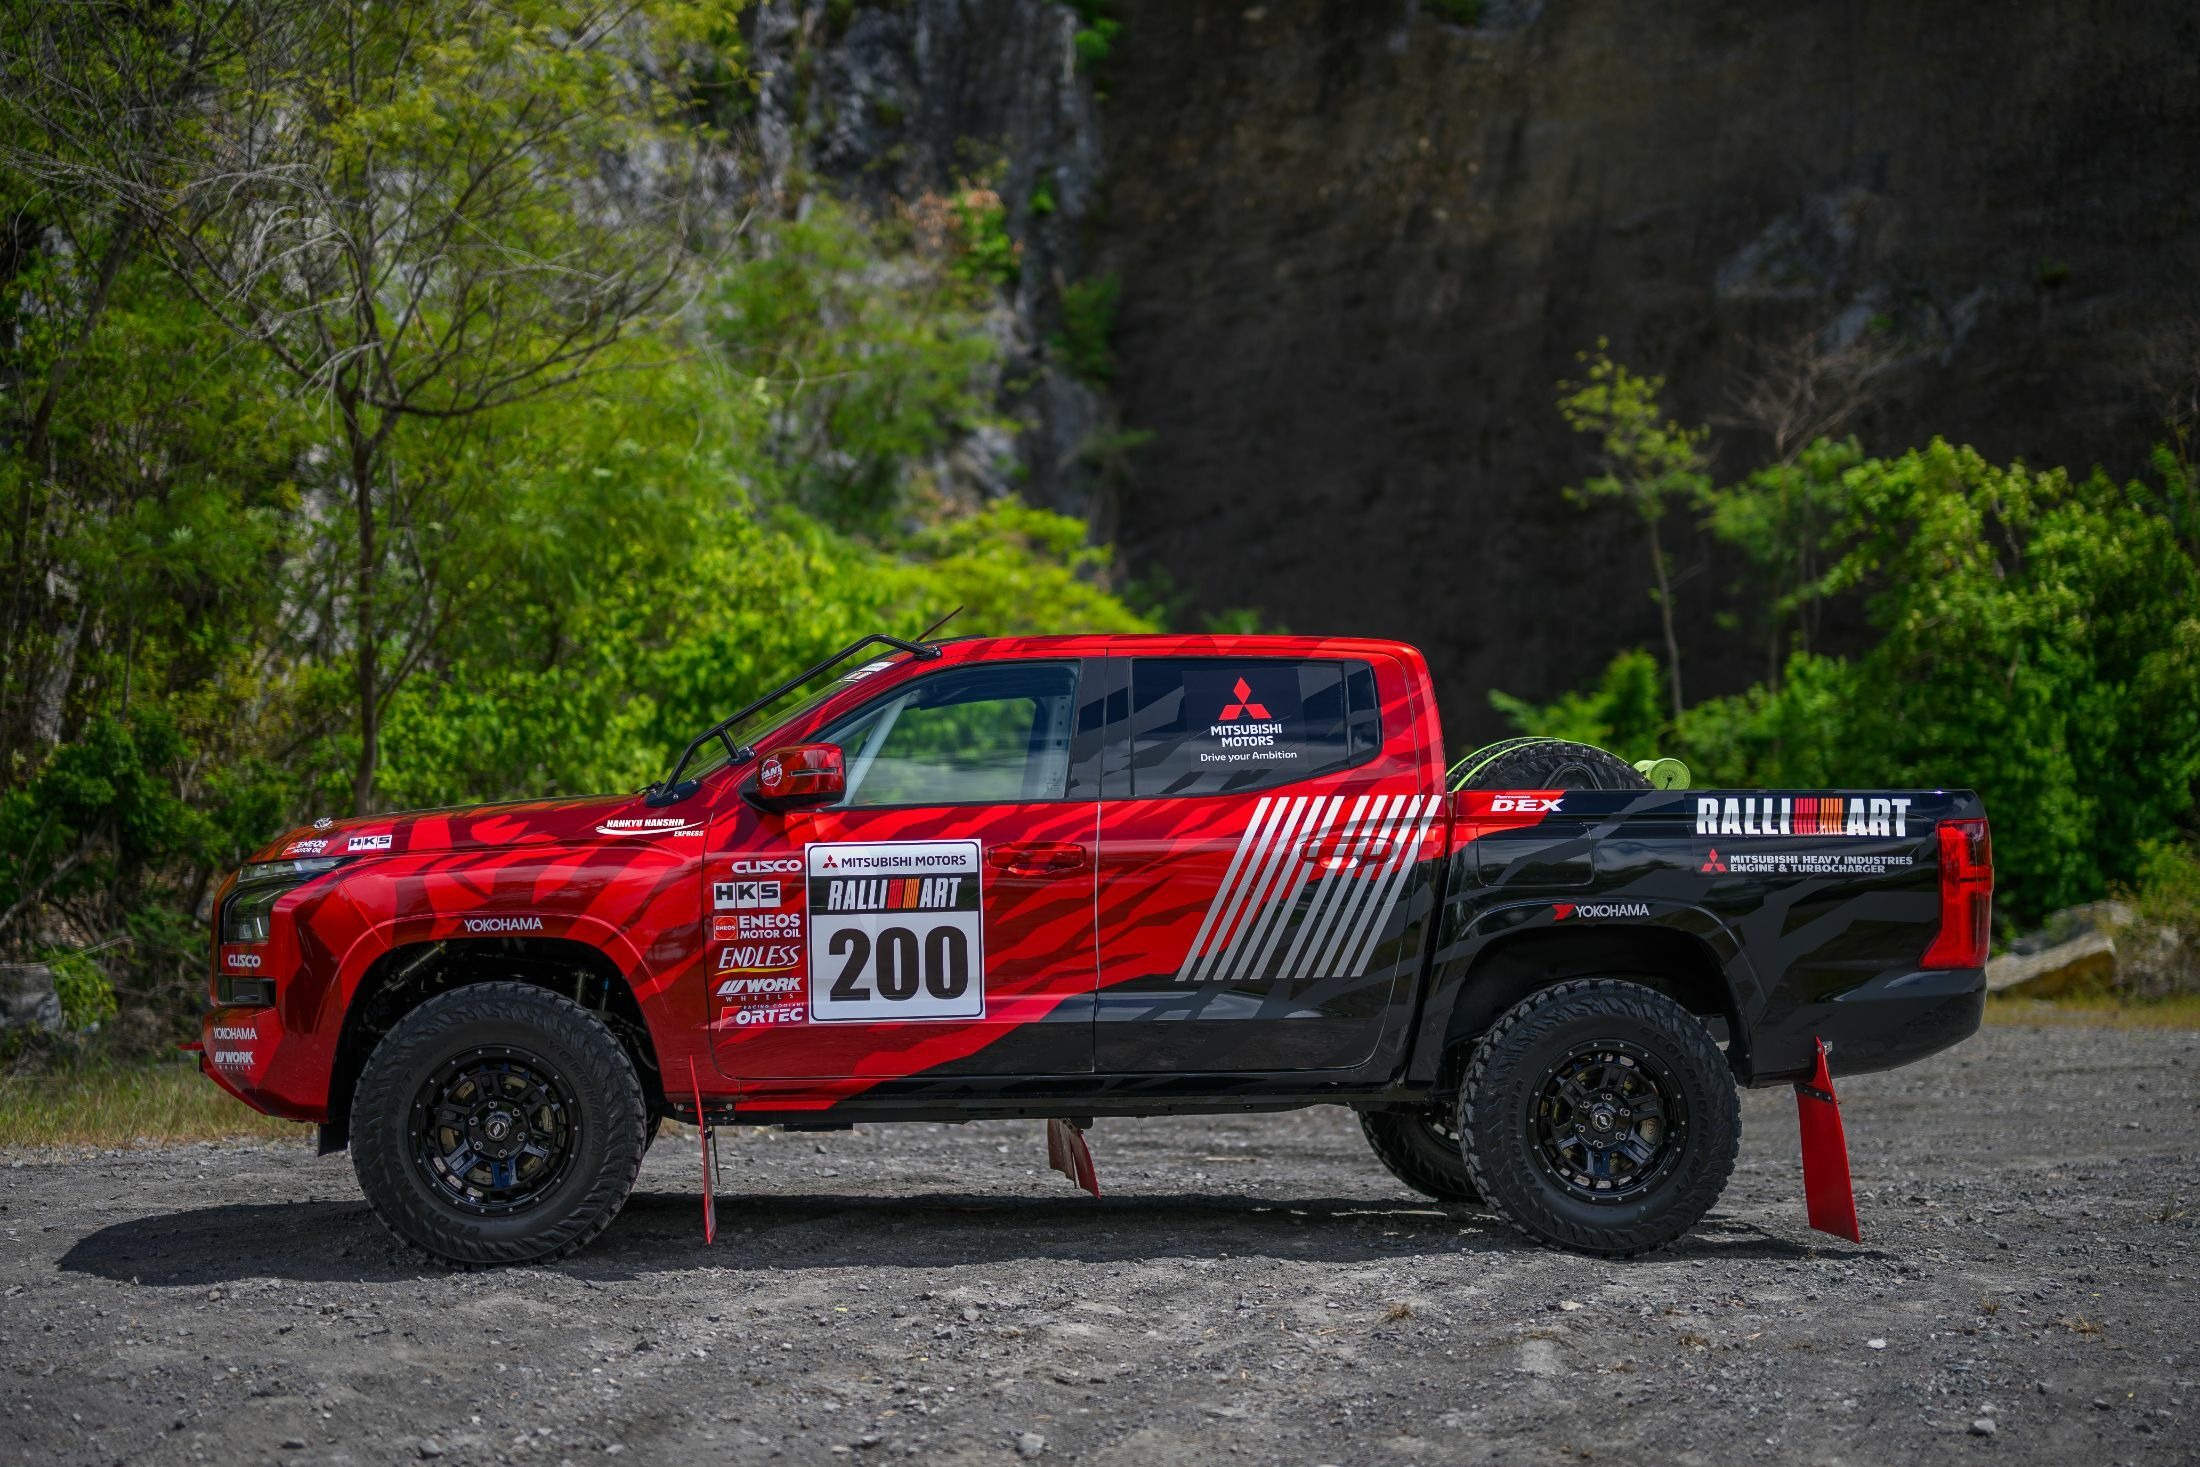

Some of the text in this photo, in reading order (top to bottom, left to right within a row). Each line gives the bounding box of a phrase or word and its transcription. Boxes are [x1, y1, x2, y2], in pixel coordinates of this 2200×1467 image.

[1210, 723, 1282, 736] MITSUBISHI
[1221, 736, 1274, 748] MOTORS
[1200, 750, 1298, 763] Drive your Ambition
[1490, 798, 1564, 812] DEX
[606, 818, 685, 828] HANKYU HANSHIN
[296, 840, 328, 848] ENEOS
[349, 836, 392, 848] HKS
[732, 859, 802, 874] CUSCO
[841, 854, 967, 868] MITSUBISHI MOTORS
[1730, 856, 1913, 865] MITSUBISHI HEAVY INDUSTRIES
[1730, 864, 1886, 874] ENGINE & TURBOCHARGER
[714, 882, 780, 902] HKS
[1576, 903, 1650, 919] YOKOHAMA
[464, 916, 544, 933] YOKOHAMA
[739, 914, 800, 928] ENEOS
[740, 928, 802, 939] MOTOR OIL
[228, 954, 261, 968] CUSCO
[718, 944, 801, 968] ENDLESS
[828, 925, 969, 1002] 200
[744, 976, 803, 993] WORK
[726, 994, 794, 1002] WHEELS
[214, 1027, 258, 1040] YOKOHAMA
